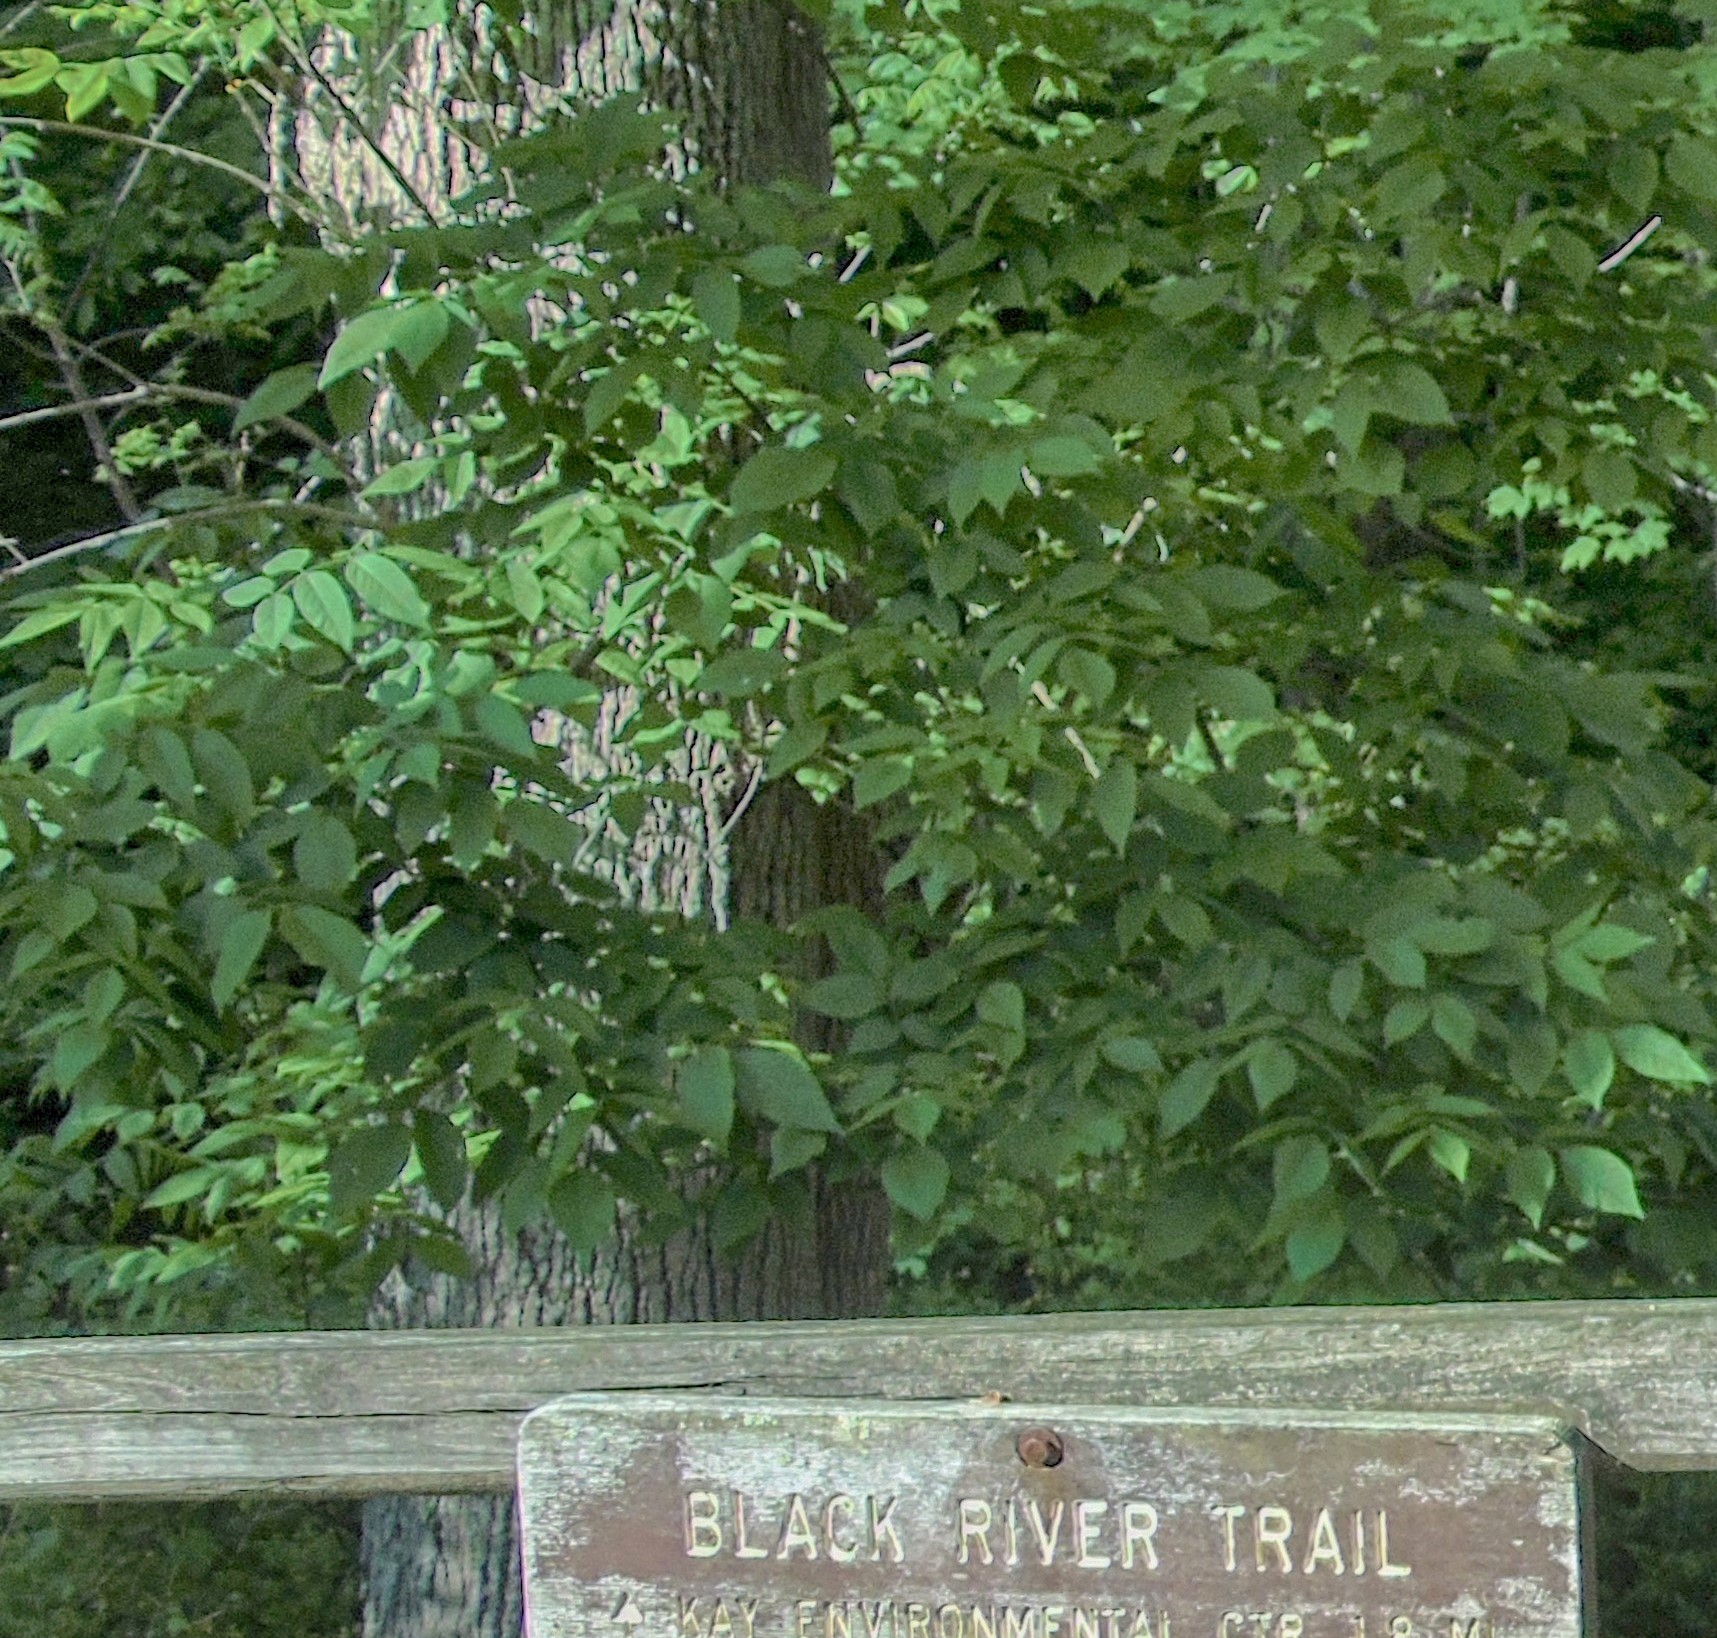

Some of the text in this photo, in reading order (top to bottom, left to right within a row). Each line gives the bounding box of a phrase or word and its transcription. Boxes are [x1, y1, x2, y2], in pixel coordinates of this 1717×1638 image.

[685, 1490, 1412, 1577] BLACK RIVER TRAIL
